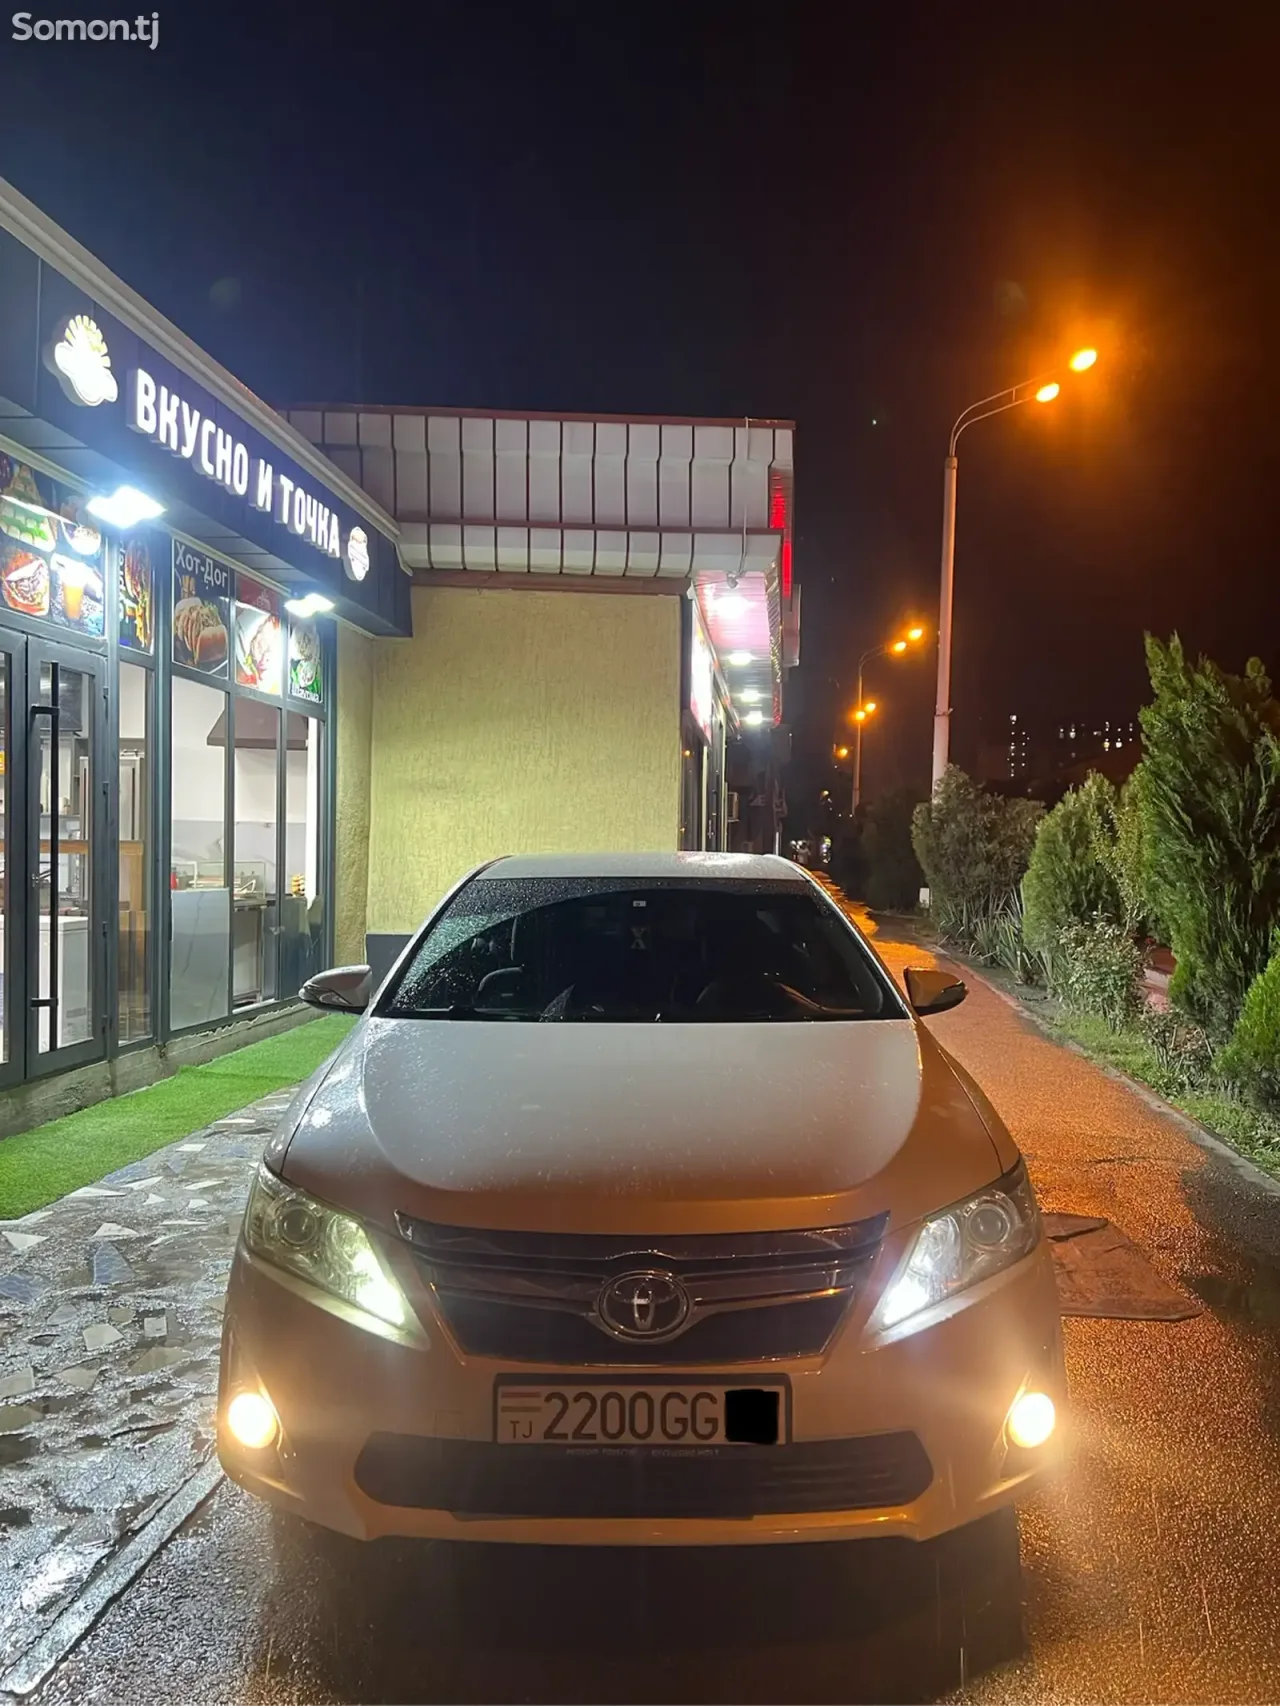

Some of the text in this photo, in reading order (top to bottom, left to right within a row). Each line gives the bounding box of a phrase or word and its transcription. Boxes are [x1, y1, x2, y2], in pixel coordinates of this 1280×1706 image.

[136, 368, 341, 559] ВКУСНО И ТОЧКА
[175, 541, 228, 588] Хот-Дог
[509, 1391, 719, 1440] TJ 2200GG
